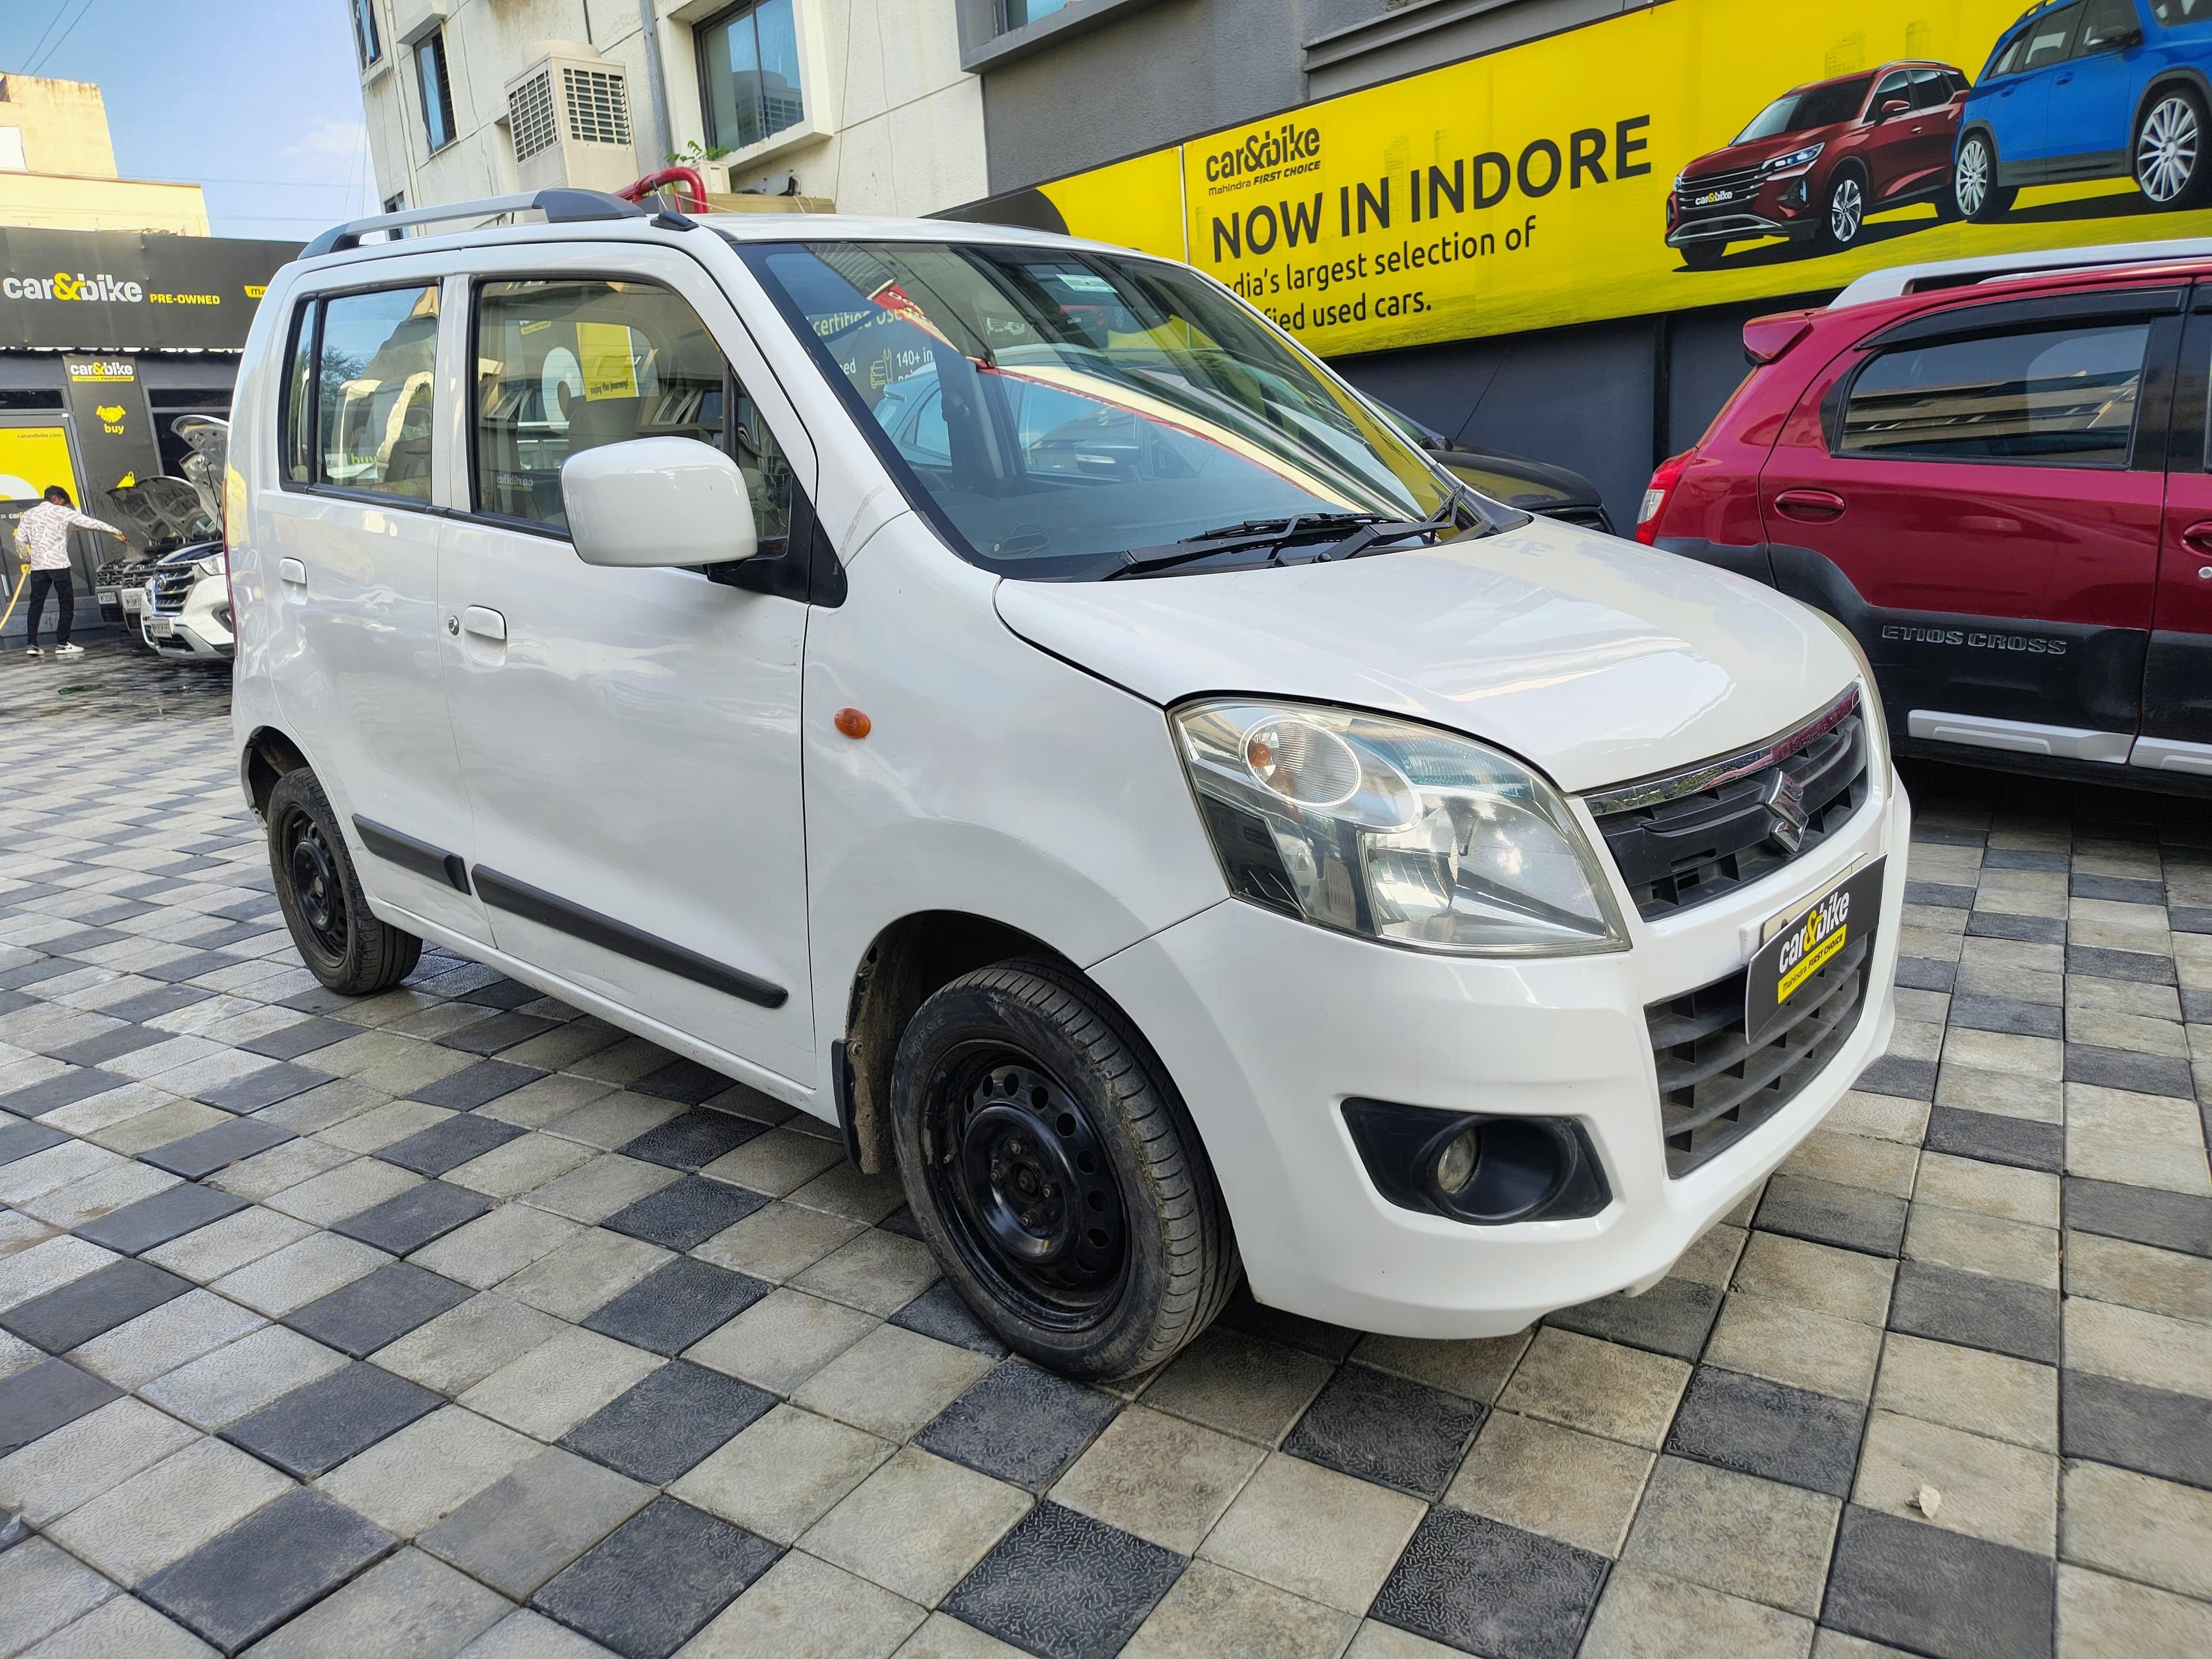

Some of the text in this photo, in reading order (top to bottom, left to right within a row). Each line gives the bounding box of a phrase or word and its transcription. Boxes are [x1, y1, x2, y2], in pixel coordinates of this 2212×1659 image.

[1206, 124, 1320, 182] car&bike
[1209, 160, 1321, 196] Mahindra FIRST CHOICE
[1213, 114, 1652, 263] NOW IN INDORE
[1695, 191, 1732, 205] car&bike
[1224, 215, 1536, 298] dia's largest selection of
[3, 272, 221, 305] car&bike PRE-OWNED
[1313, 292, 1367, 328] used
[1374, 291, 1432, 319] cars.
[70, 361, 133, 376] car&bike
[896, 350, 921, 368] 140+
[104, 423, 124, 434] buy
[1882, 624, 2067, 655] ETIOS CROSS
[1779, 891, 1850, 974] car&bike
